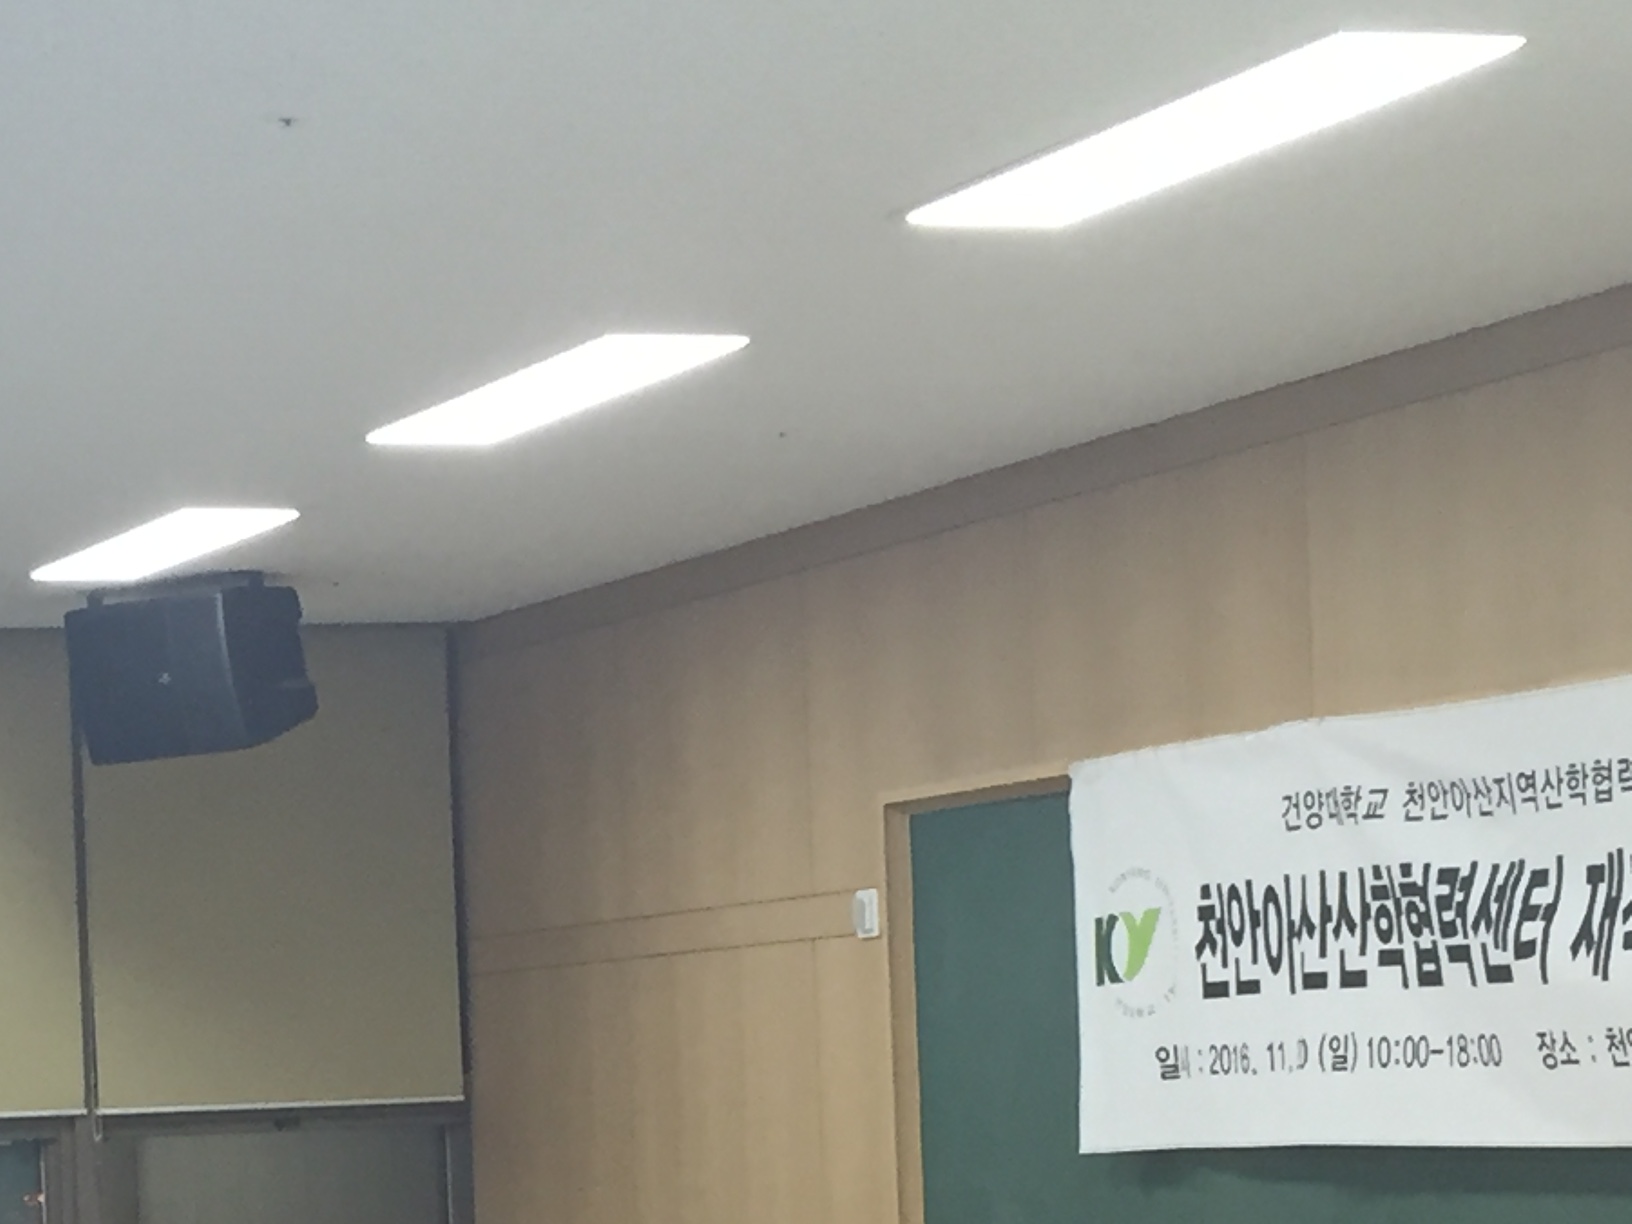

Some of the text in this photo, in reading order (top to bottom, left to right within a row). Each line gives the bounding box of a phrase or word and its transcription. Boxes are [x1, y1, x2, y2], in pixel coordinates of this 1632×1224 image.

[1282, 784, 1389, 832] 건양대학교
[1194, 854, 1565, 999] 천안아산산학협력센터
[1569, 847, 1632, 983] 재
[1318, 1031, 1358, 1074] (일)
[1366, 1033, 1503, 1069] 10:00-18:00
[1535, 1029, 1581, 1070] 장소
[1605, 1026, 1632, 1067] 천
